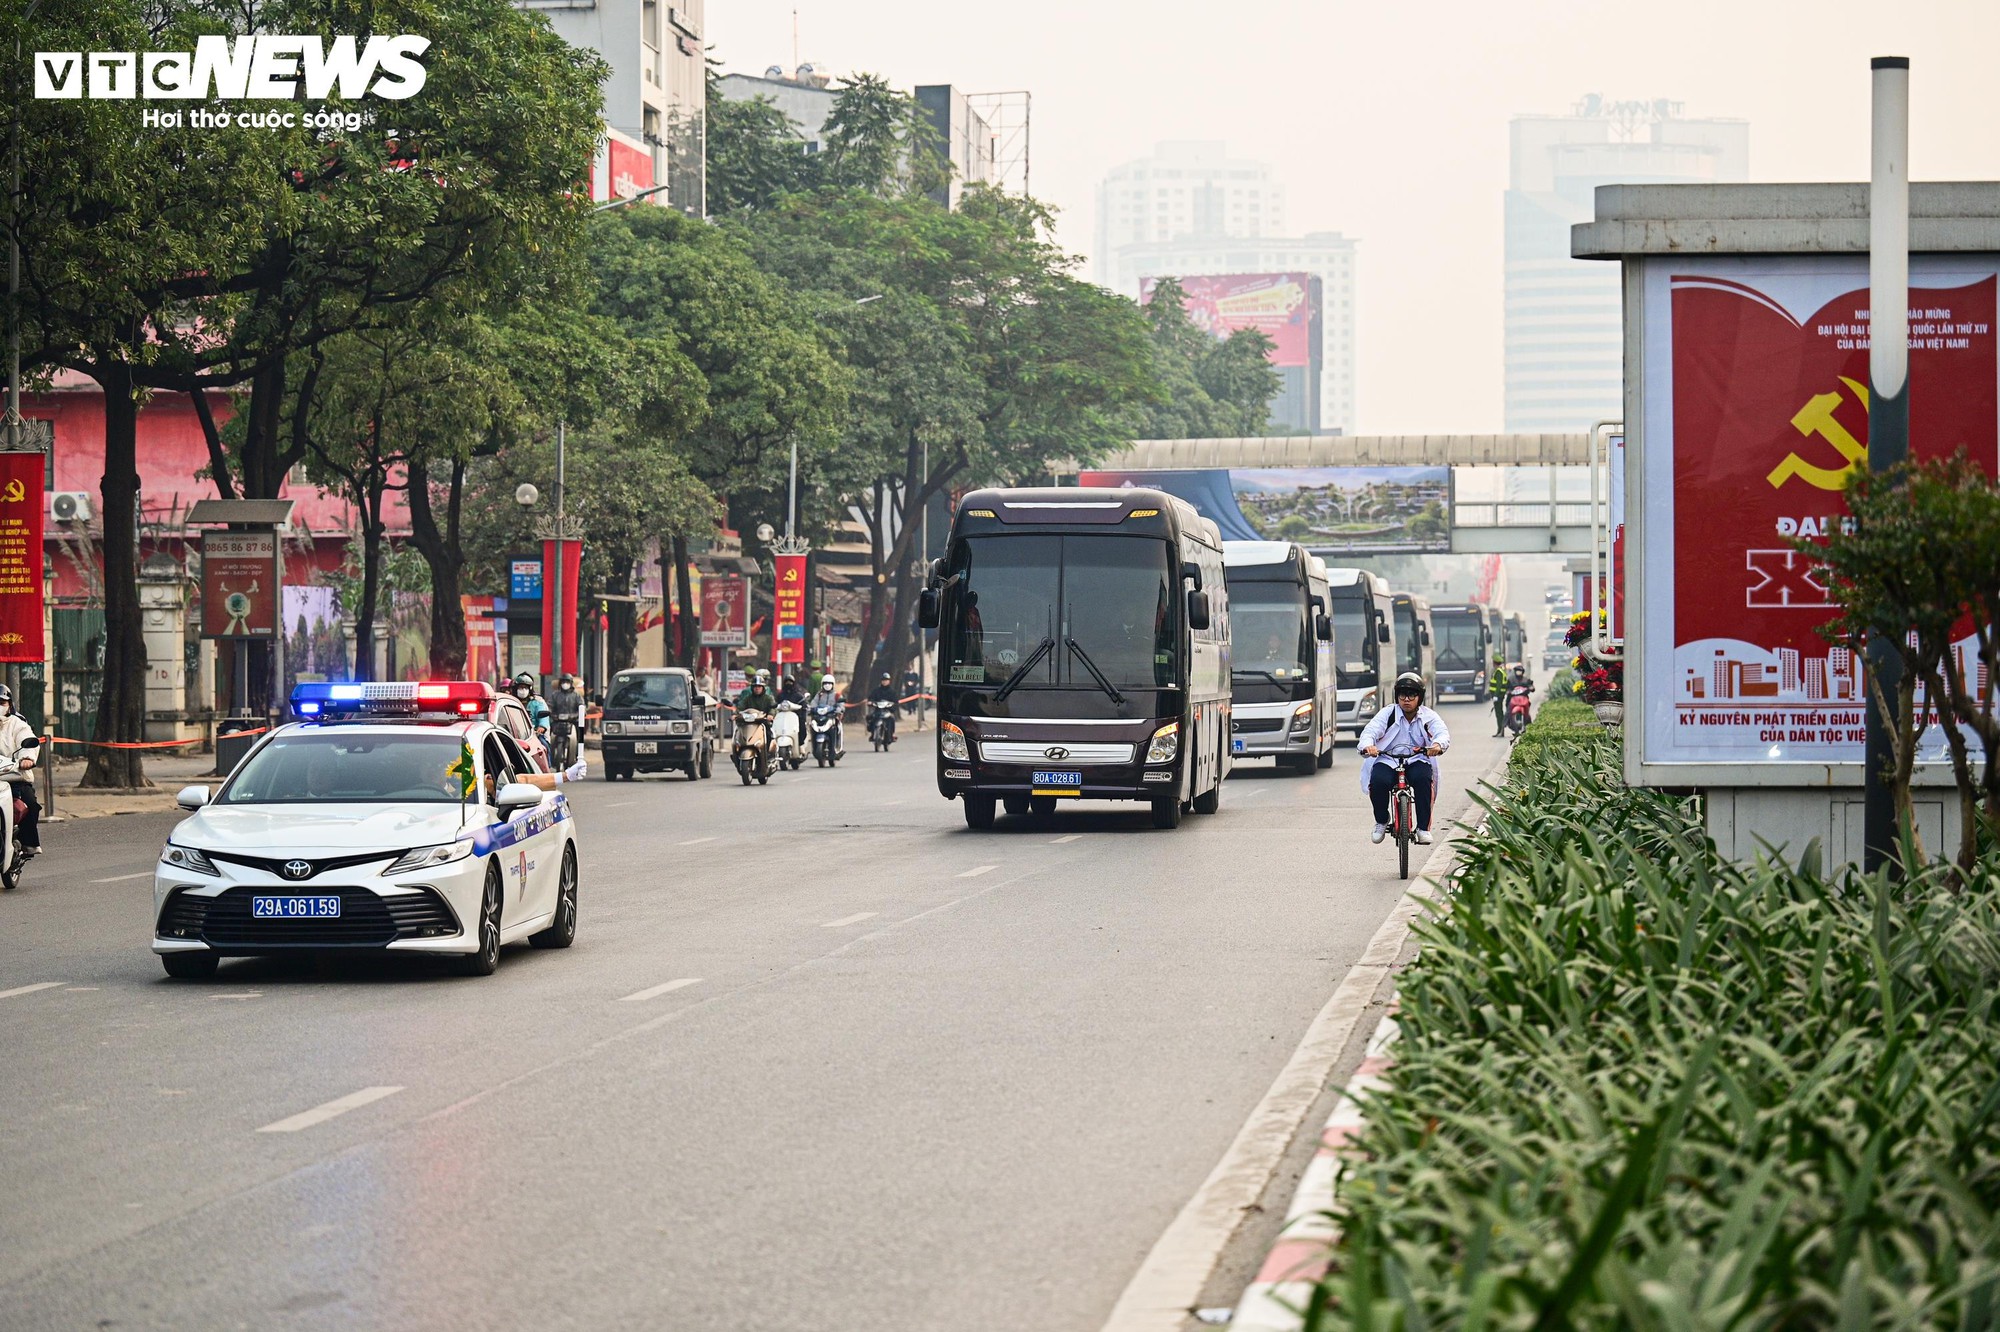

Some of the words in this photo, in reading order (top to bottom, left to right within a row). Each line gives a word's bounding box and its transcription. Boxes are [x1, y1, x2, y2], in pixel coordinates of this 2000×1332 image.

[1855, 309, 1870, 320] NHI
[1907, 307, 1923, 320] HÀO
[1925, 307, 1951, 320] MỪNG
[1818, 324, 1832, 337] ĐẠI
[1834, 323, 1849, 337] HỘI
[1850, 324, 1865, 337] ĐẠI
[1912, 321, 1935, 335] QUỐC
[1956, 321, 1973, 334] THỨ
[1974, 324, 1988, 334] XIV
[1837, 336, 1854, 349] CỦA
[1907, 335, 1924, 349] SẢN
[1926, 337, 1944, 351] VIỆT
[1946, 338, 1969, 349] NAM!
[205, 542, 228, 552] 0865
[231, 542, 243, 552] 86
[246, 542, 258, 552] 87
[261, 542, 273, 552] 86
[1000, 652, 1017, 662] VN
[1680, 709, 1696, 725] KỶ
[1700, 711, 1750, 725] NGUYÊN
[1754, 711, 1786, 725] PHÁT
[1790, 709, 1826, 725] TRIỂN
[1830, 711, 1859, 725] GIÀU
[1760, 726, 1785, 742] CỦA
[1789, 728, 1815, 742] DÂN
[1819, 728, 1843, 744] TỘC
[1846, 728, 1866, 744] VIỆ
[1034, 773, 1080, 784] 80A-028.61
[255, 898, 338, 916] 29A-061.59
